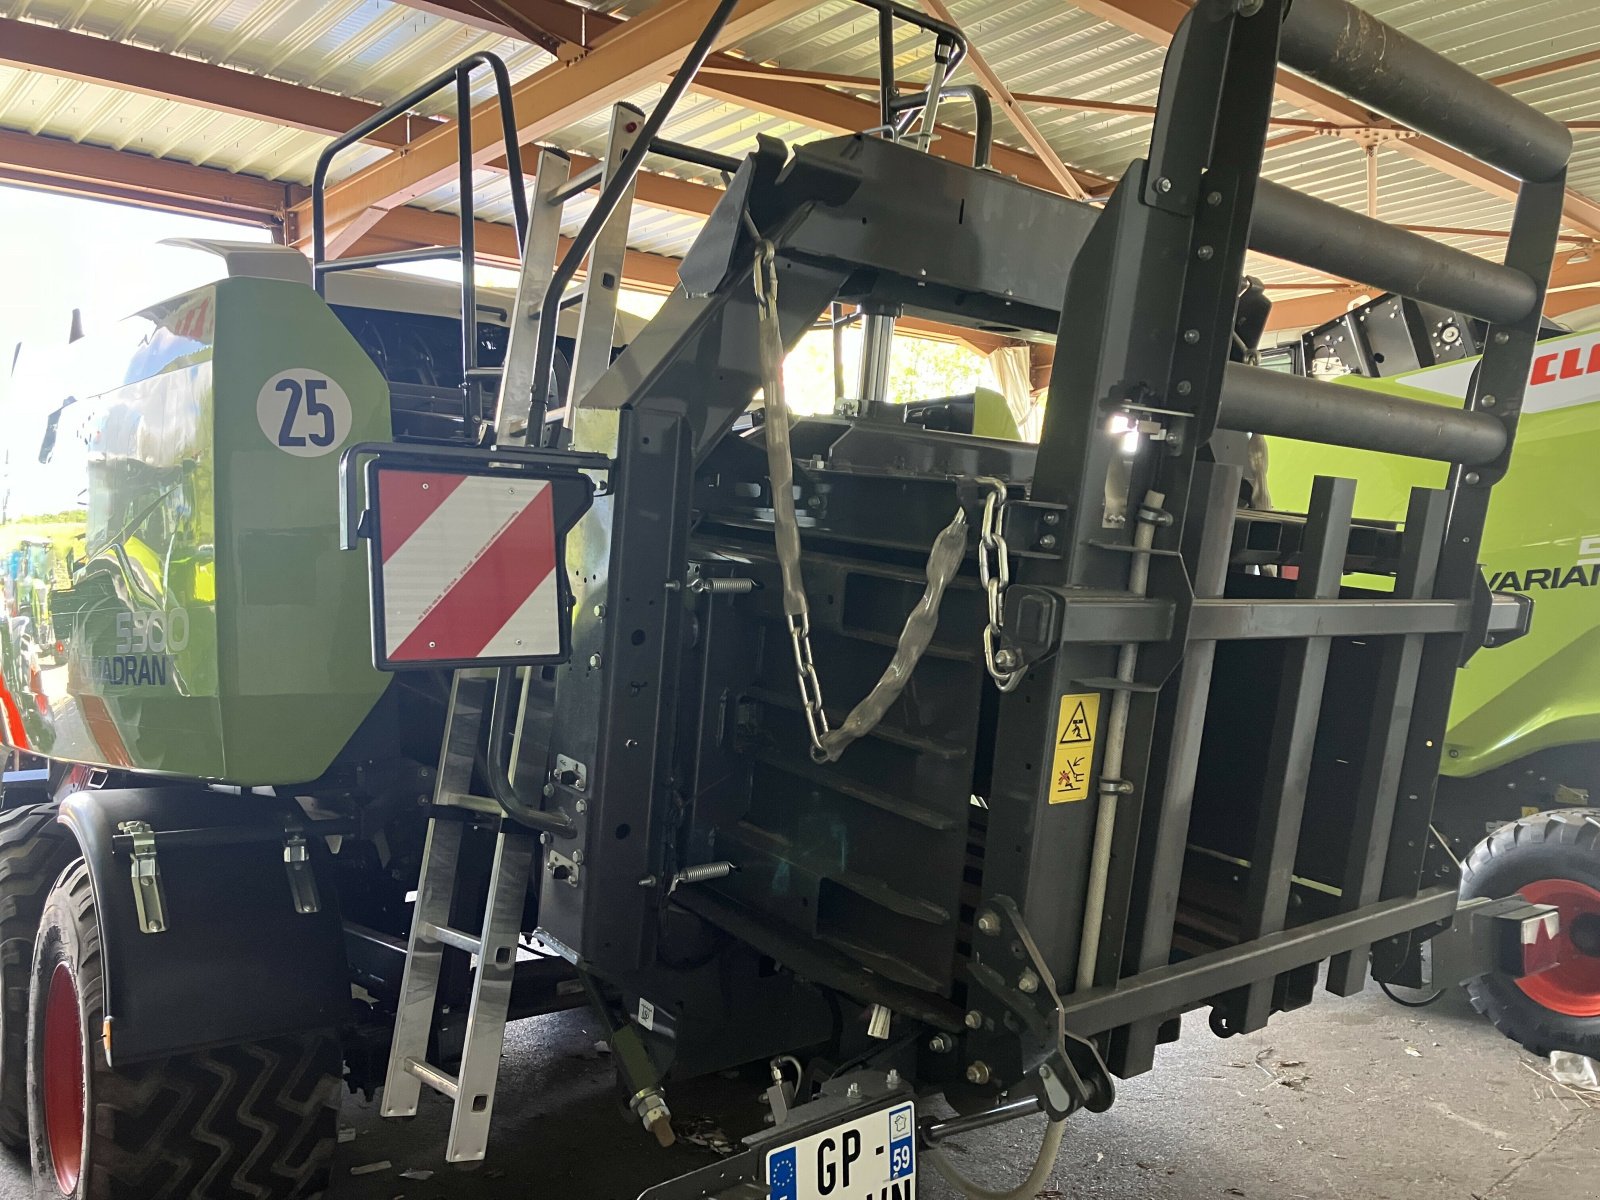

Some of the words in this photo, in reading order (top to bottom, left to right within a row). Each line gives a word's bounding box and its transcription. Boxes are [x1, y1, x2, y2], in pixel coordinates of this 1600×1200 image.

[275, 379, 335, 447] 25
[80, 654, 178, 686] UADRANT
[893, 1145, 910, 1171] 59
